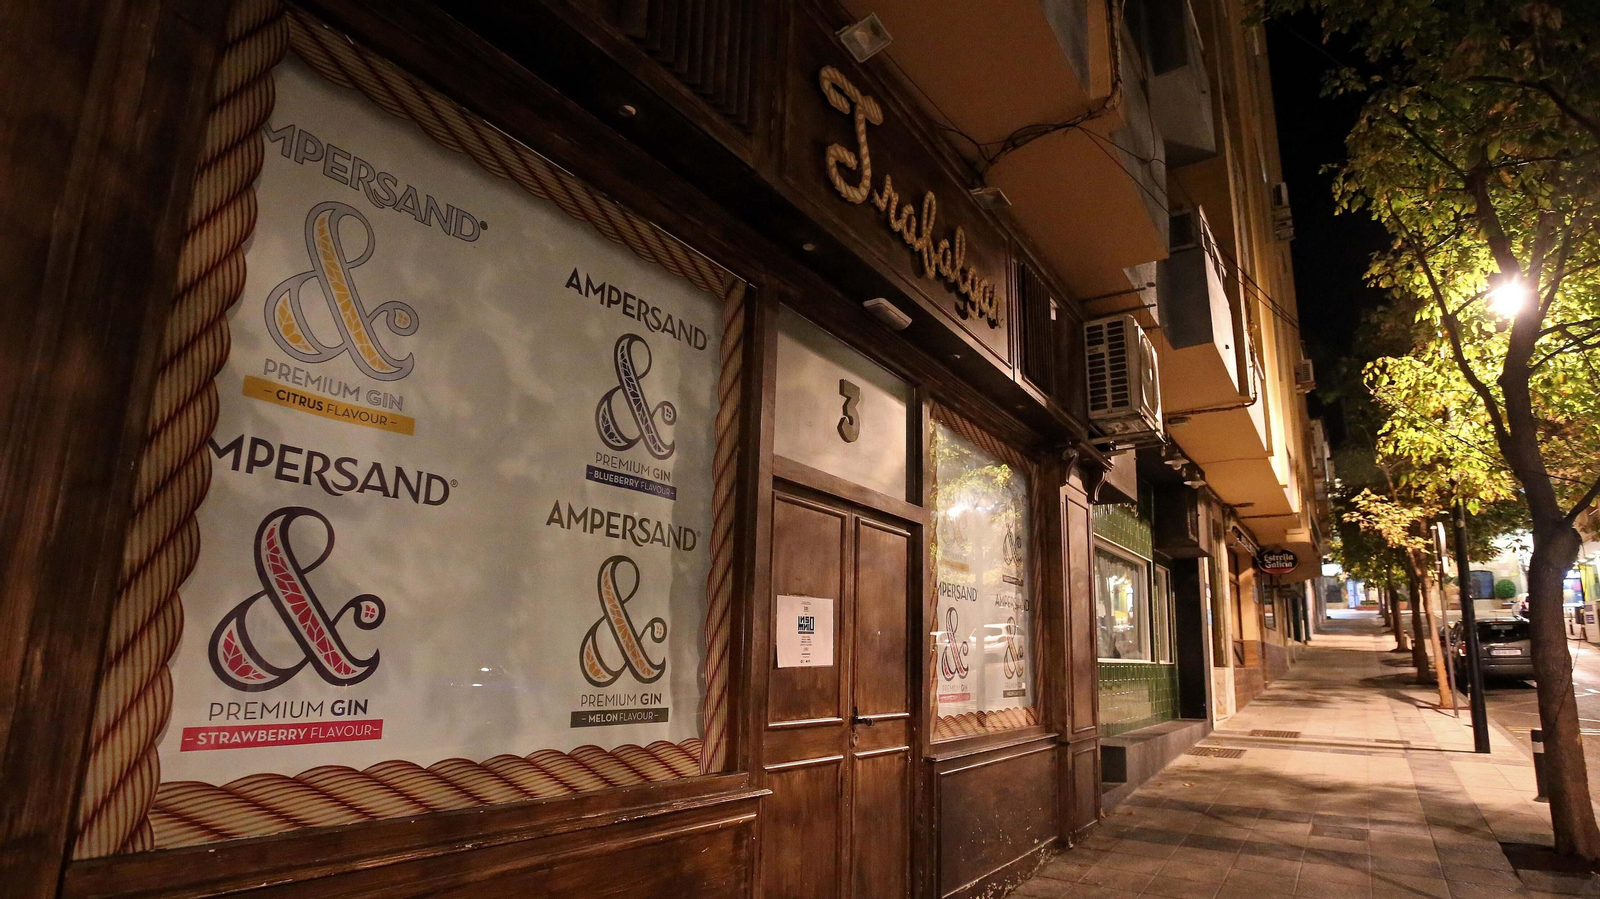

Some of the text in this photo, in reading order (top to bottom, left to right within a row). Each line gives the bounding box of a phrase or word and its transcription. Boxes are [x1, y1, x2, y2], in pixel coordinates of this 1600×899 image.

[565, 267, 708, 351] AMPERSAND
[263, 358, 404, 412] PREMIUM GIN
[276, 389, 388, 426] CITRUS FLAVOUR
[837, 379, 861, 443] 3
[595, 451, 671, 483] PREMIUM GIN
[593, 470, 671, 496] BLUEBERRY FLAVOUR
[546, 499, 697, 551] AMPERSAND
[1264, 553, 1294, 561] Estrella
[1264, 560, 1293, 569] Galicia
[208, 699, 369, 722] PREMIUM GIN
[580, 693, 662, 708] PREMIUM GIN
[588, 711, 654, 724] MELON FLAVOUR
[196, 724, 373, 746] STRAWBERRY FLAVOUR
